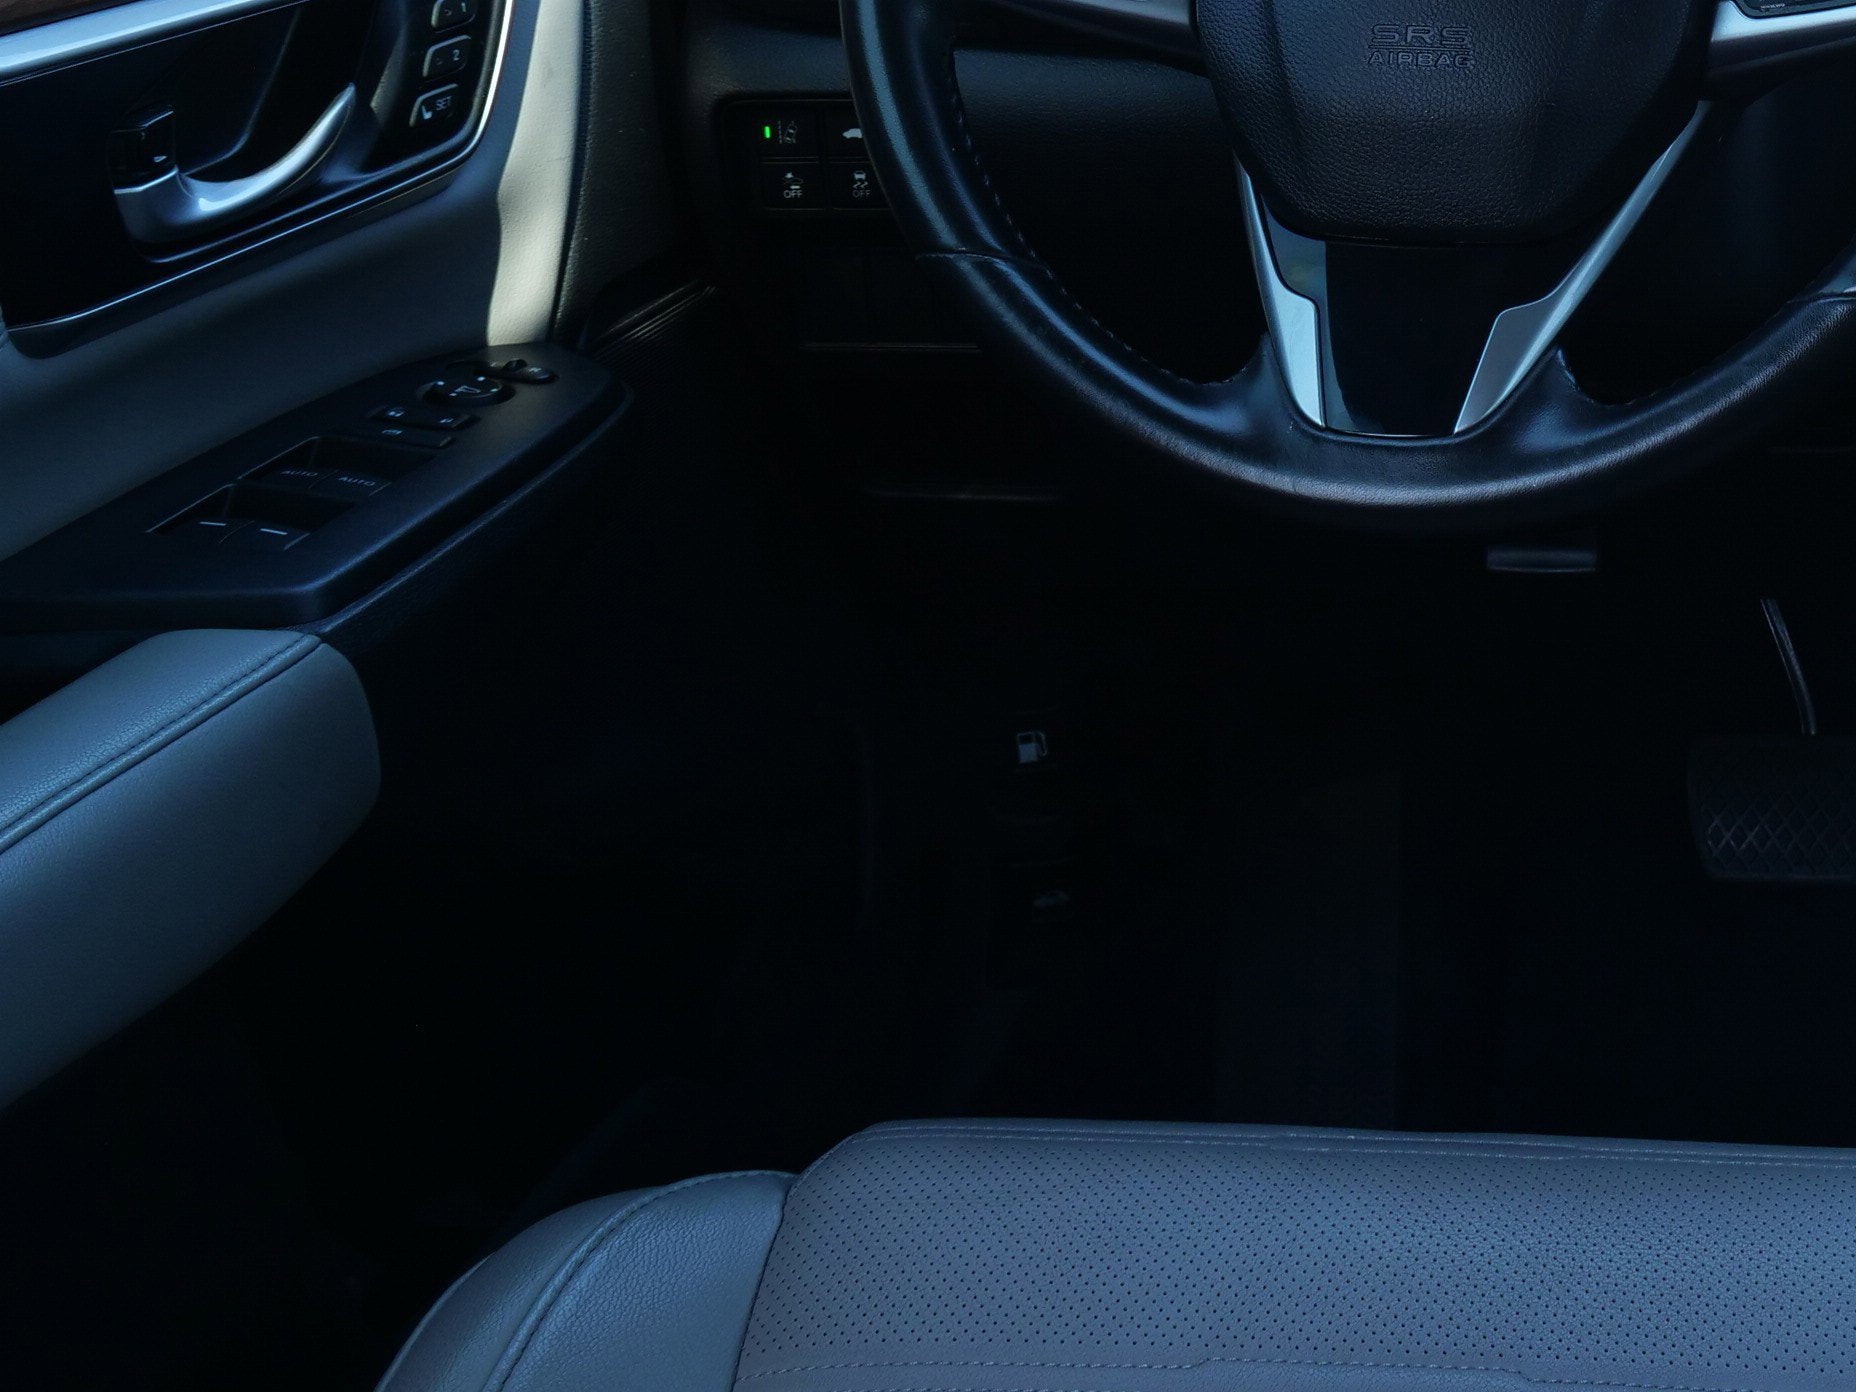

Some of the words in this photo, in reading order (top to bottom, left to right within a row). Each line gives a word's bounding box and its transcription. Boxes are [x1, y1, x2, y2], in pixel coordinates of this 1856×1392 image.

[1367, 50, 1474, 68] AIRBAG
[783, 190, 803, 199] OFF
[852, 189, 871, 198] OFF
[337, 476, 376, 486] AUTO
